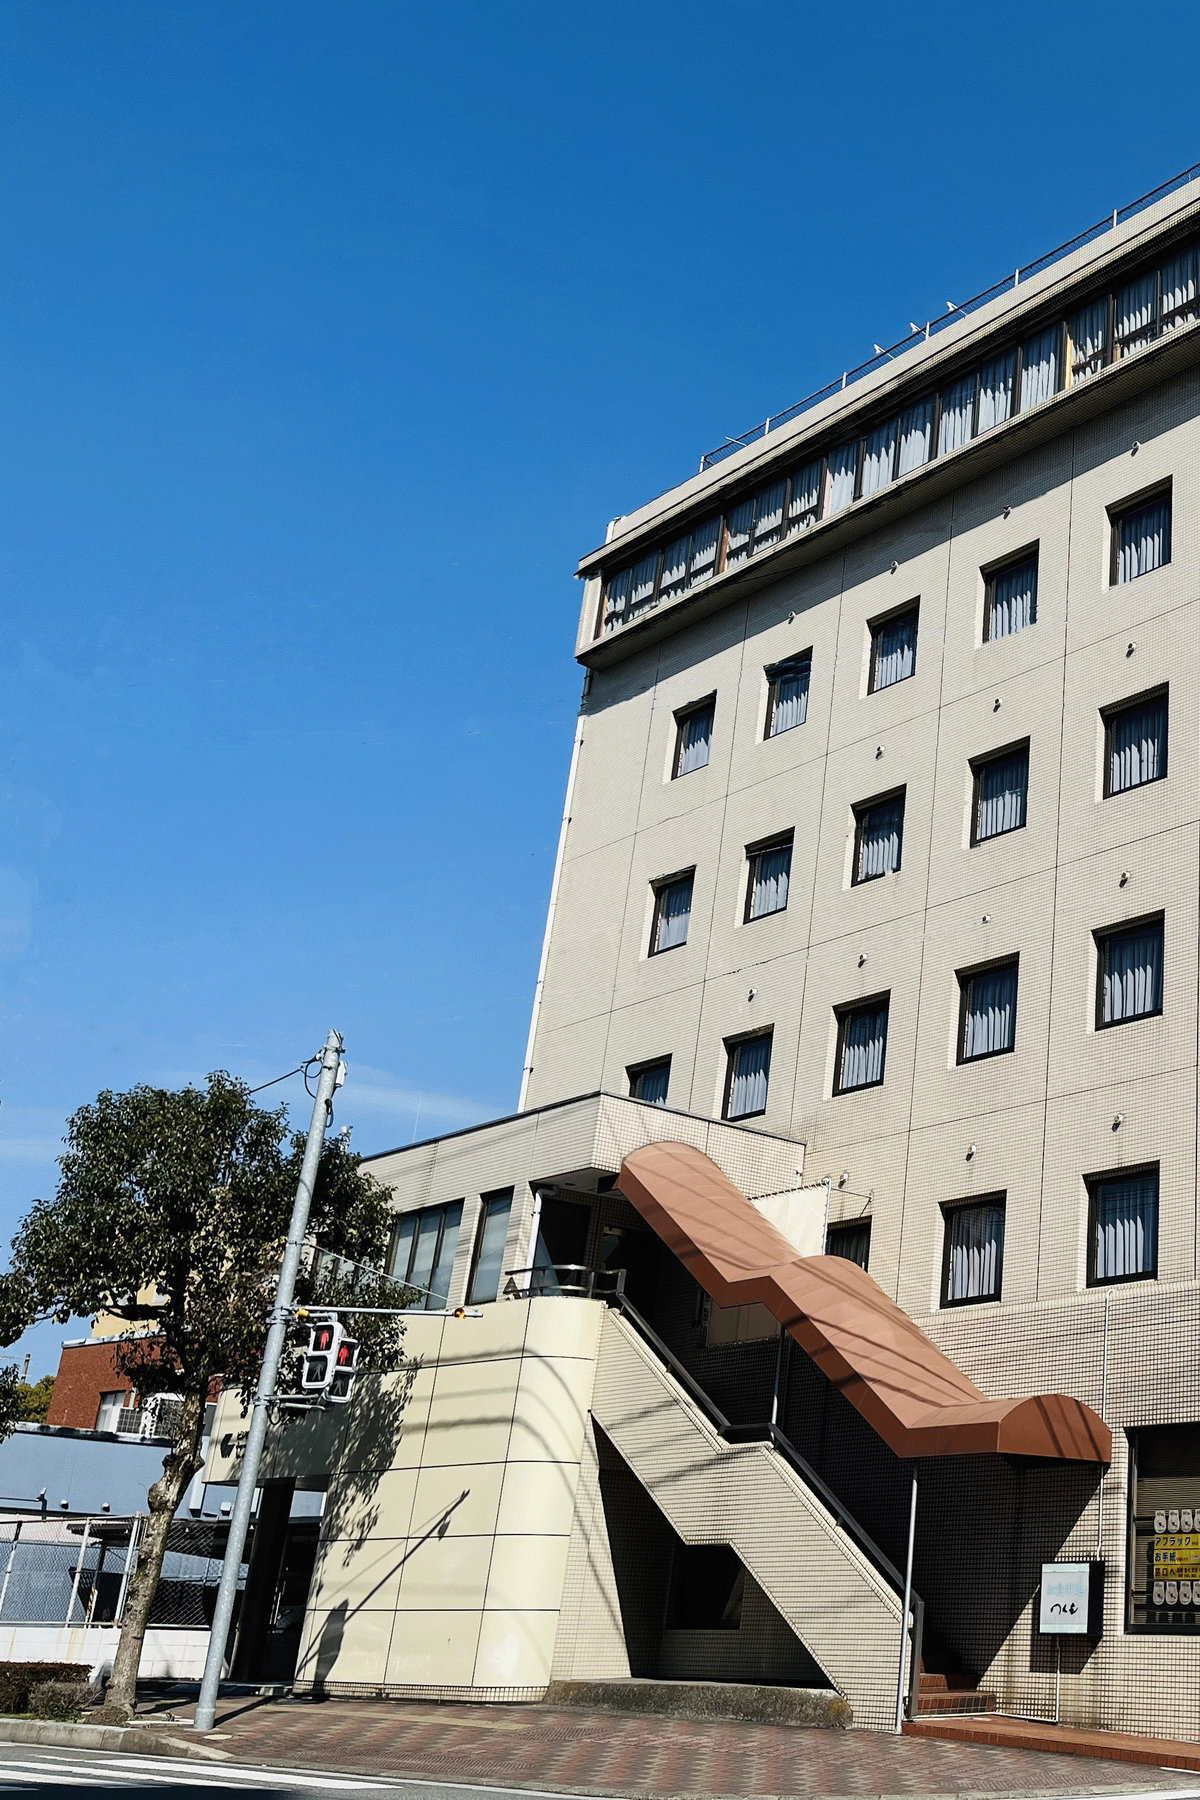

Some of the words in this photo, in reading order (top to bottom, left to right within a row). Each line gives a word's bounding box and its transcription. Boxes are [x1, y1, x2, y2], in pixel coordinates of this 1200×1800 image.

[1155, 1536, 1191, 1547] アフラック
